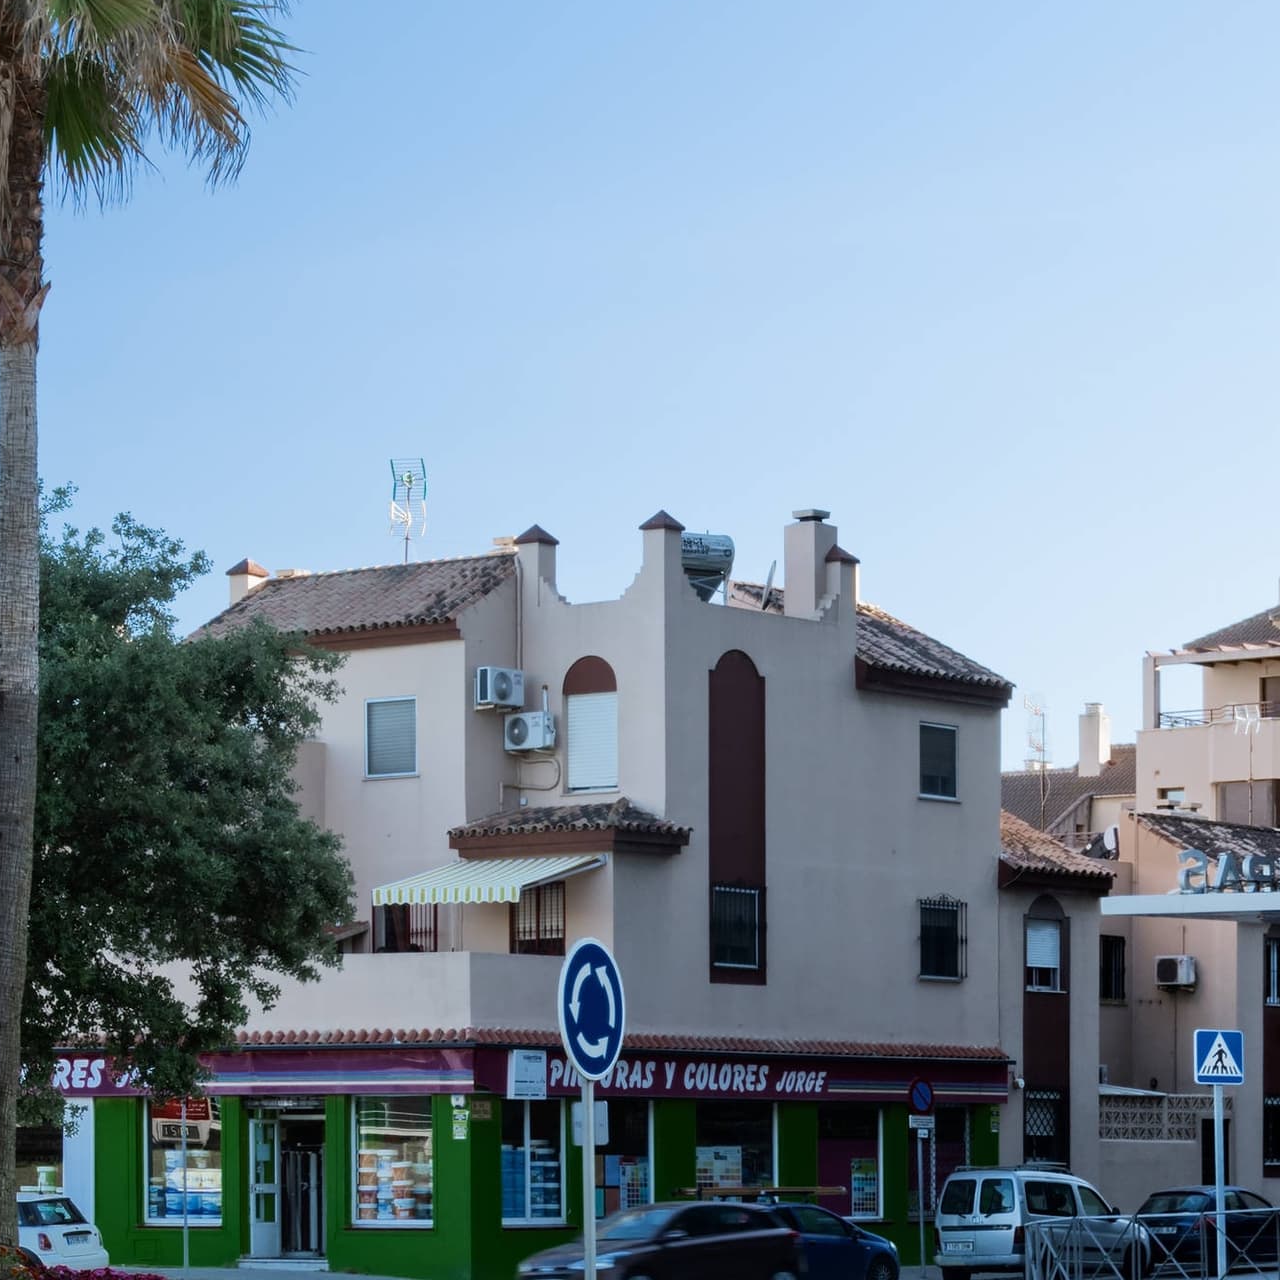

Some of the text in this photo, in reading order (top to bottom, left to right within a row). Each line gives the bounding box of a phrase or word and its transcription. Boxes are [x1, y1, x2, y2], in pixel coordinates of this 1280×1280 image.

[664, 1061, 677, 1089] Y
[683, 1062, 769, 1092] COLORES
[775, 1071, 827, 1093] JORGE
